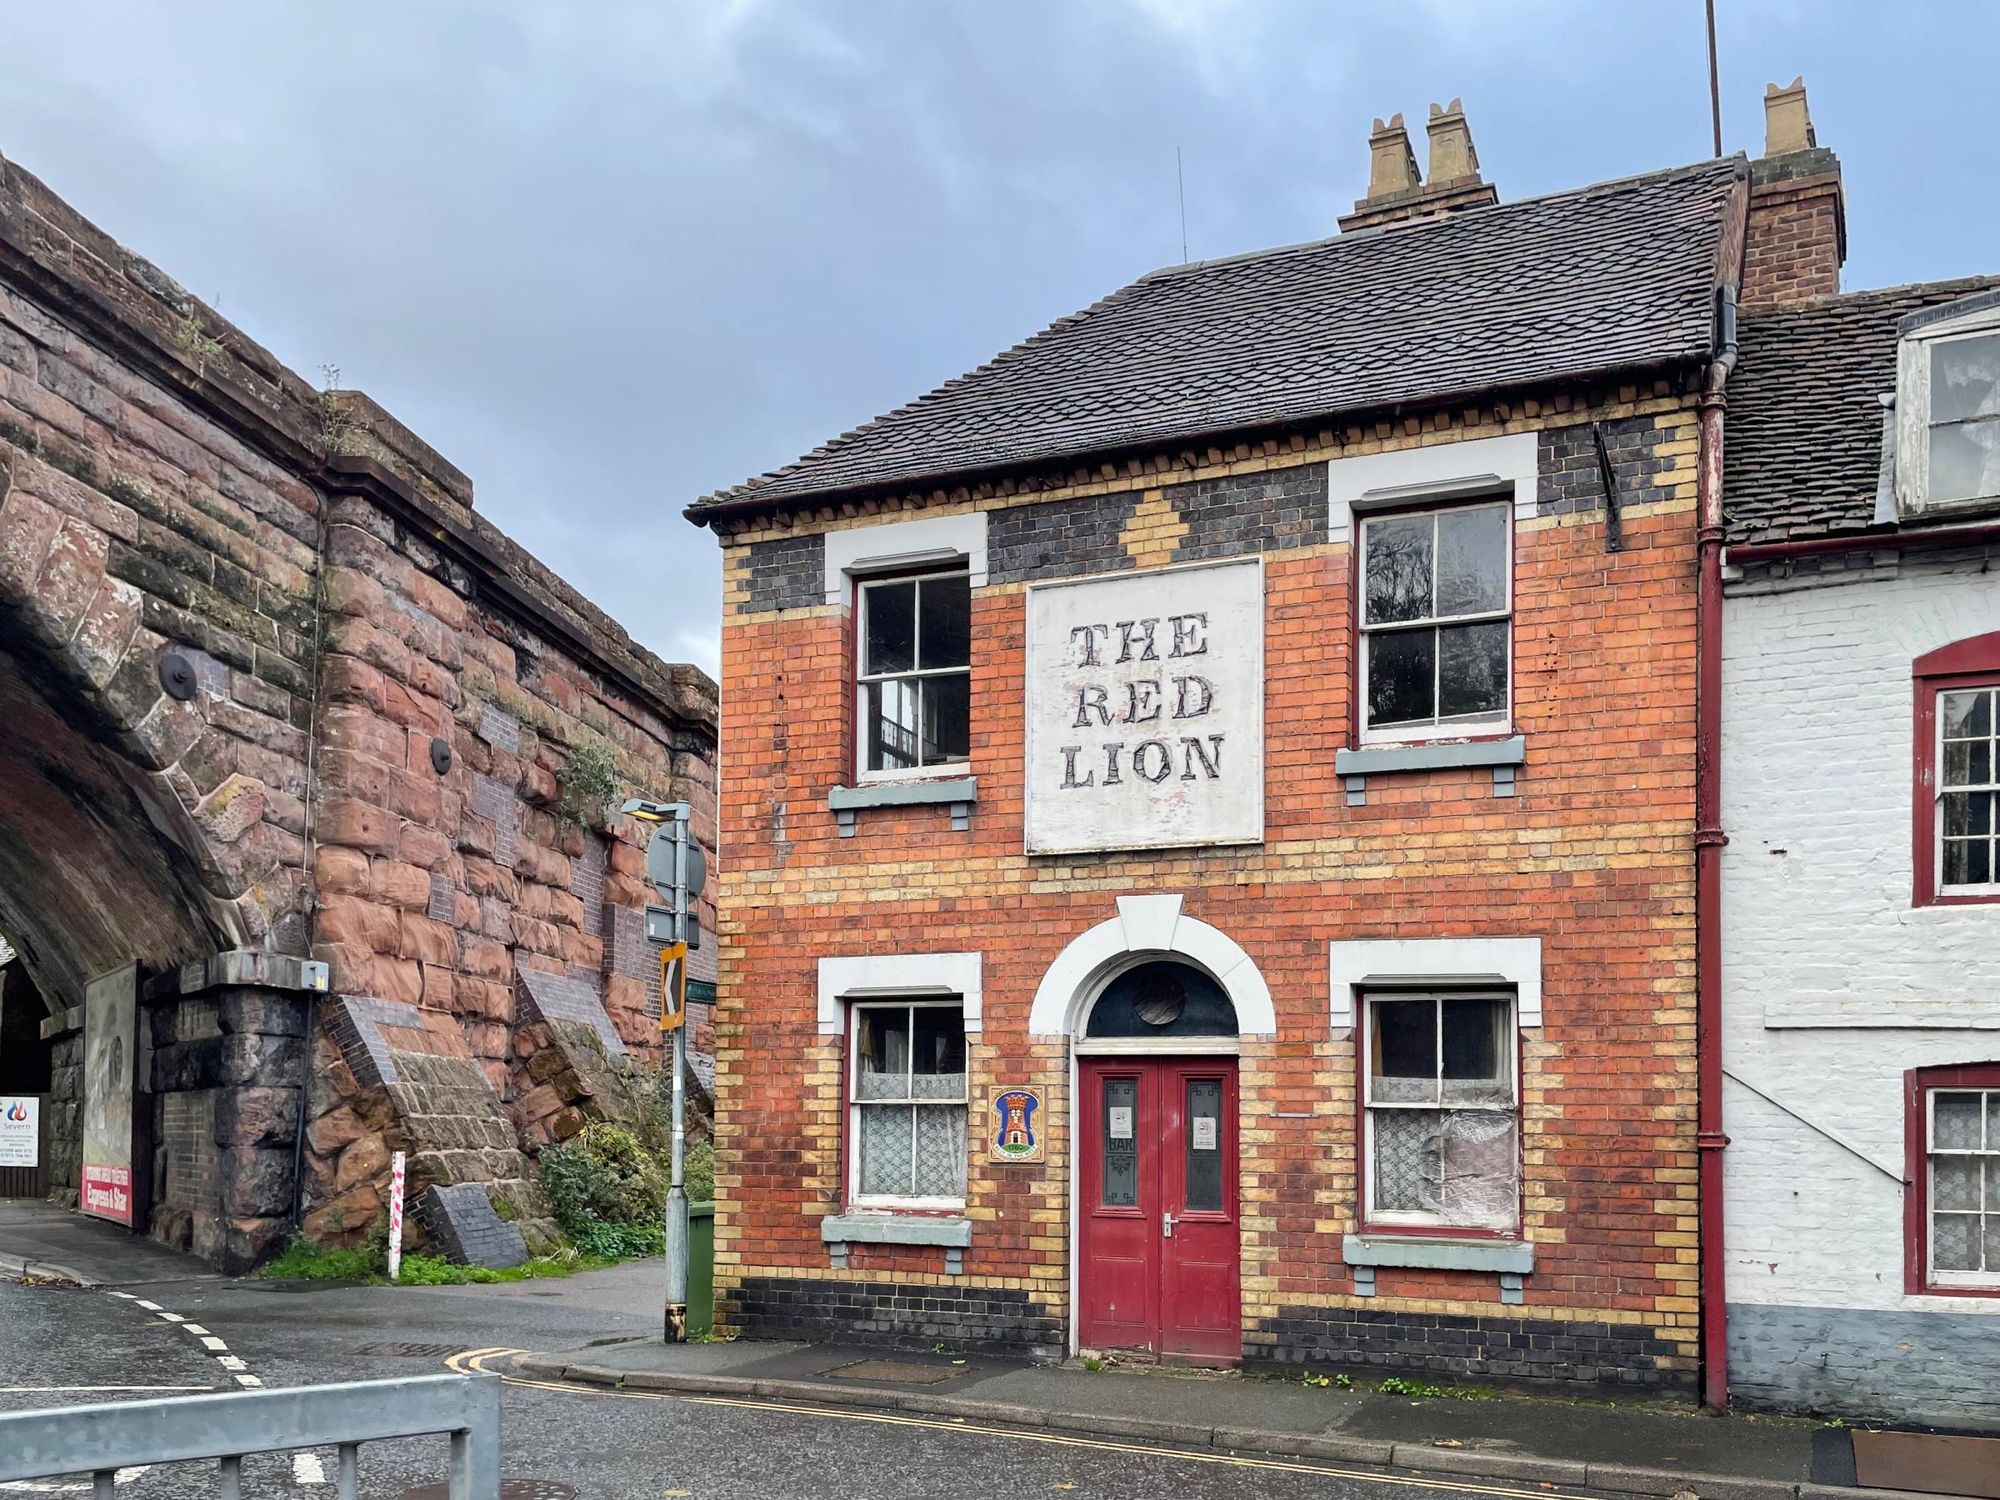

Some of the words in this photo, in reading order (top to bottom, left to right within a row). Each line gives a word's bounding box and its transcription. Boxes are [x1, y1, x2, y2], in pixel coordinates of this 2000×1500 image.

[1070, 611, 1208, 669] THE
[1072, 675, 1214, 728] RED
[1059, 733, 1225, 790] LION
[1109, 1138, 1132, 1151] BAR
[87, 1183, 110, 1211] Express
[113, 1187, 126, 1211] Star
